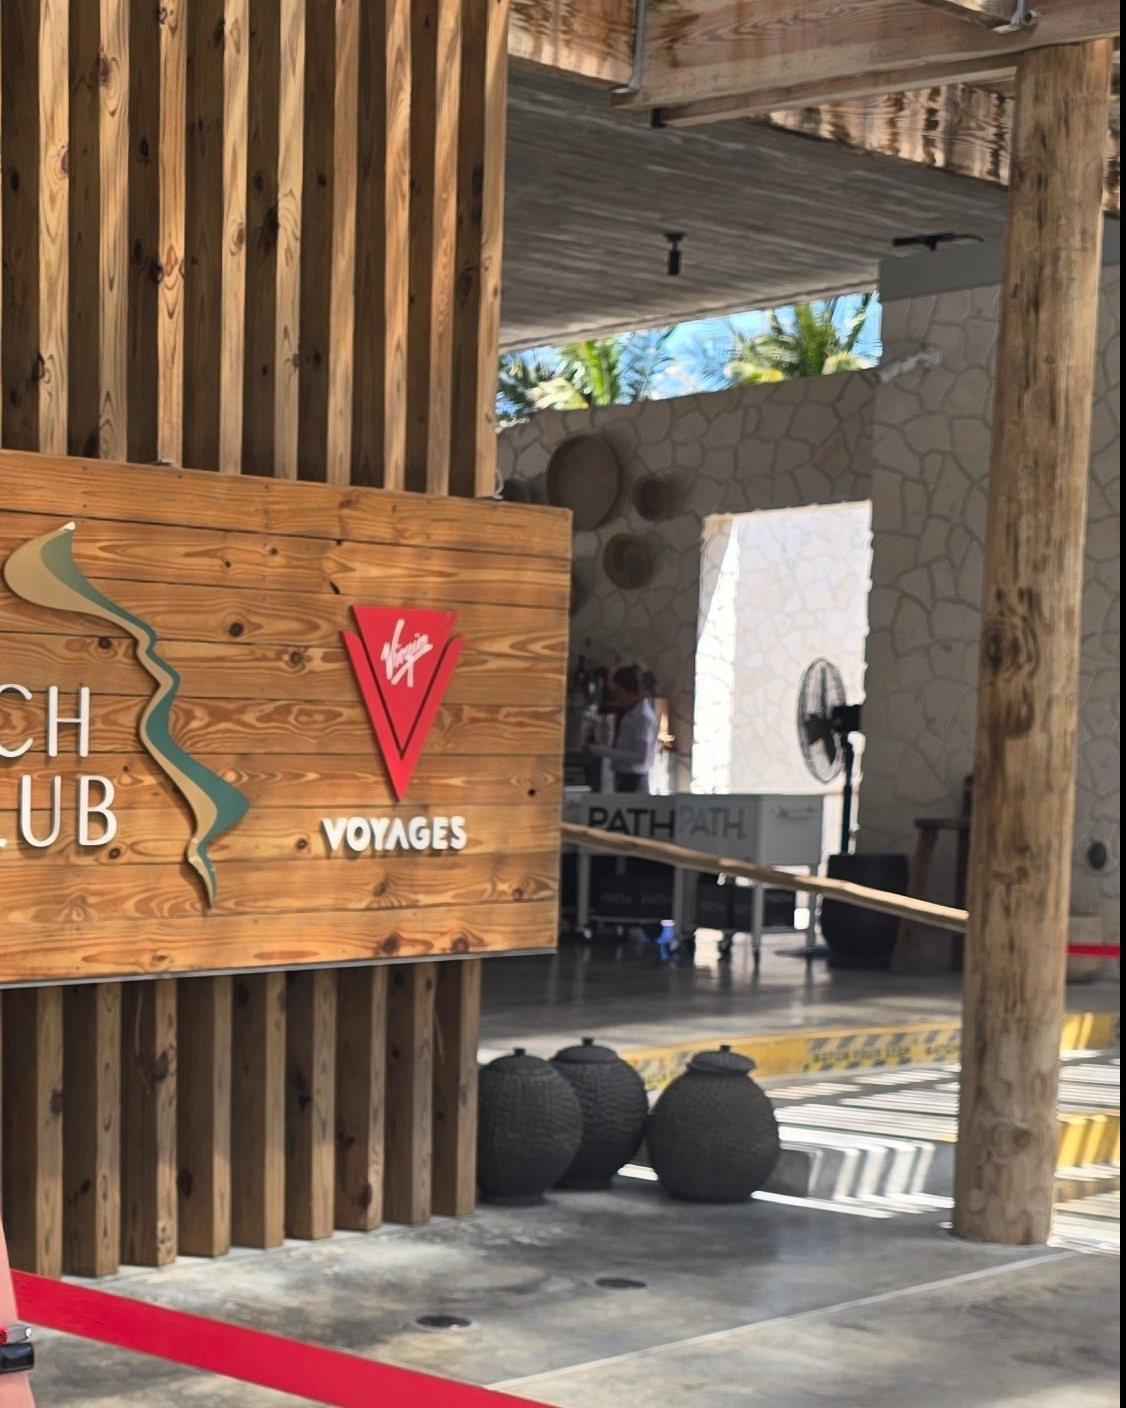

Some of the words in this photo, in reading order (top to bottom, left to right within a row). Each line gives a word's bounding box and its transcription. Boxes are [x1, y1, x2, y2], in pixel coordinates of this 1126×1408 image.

[380, 618, 433, 688] Virgin
[321, 815, 468, 852] VOYAGES
[588, 806, 675, 838] PATH
